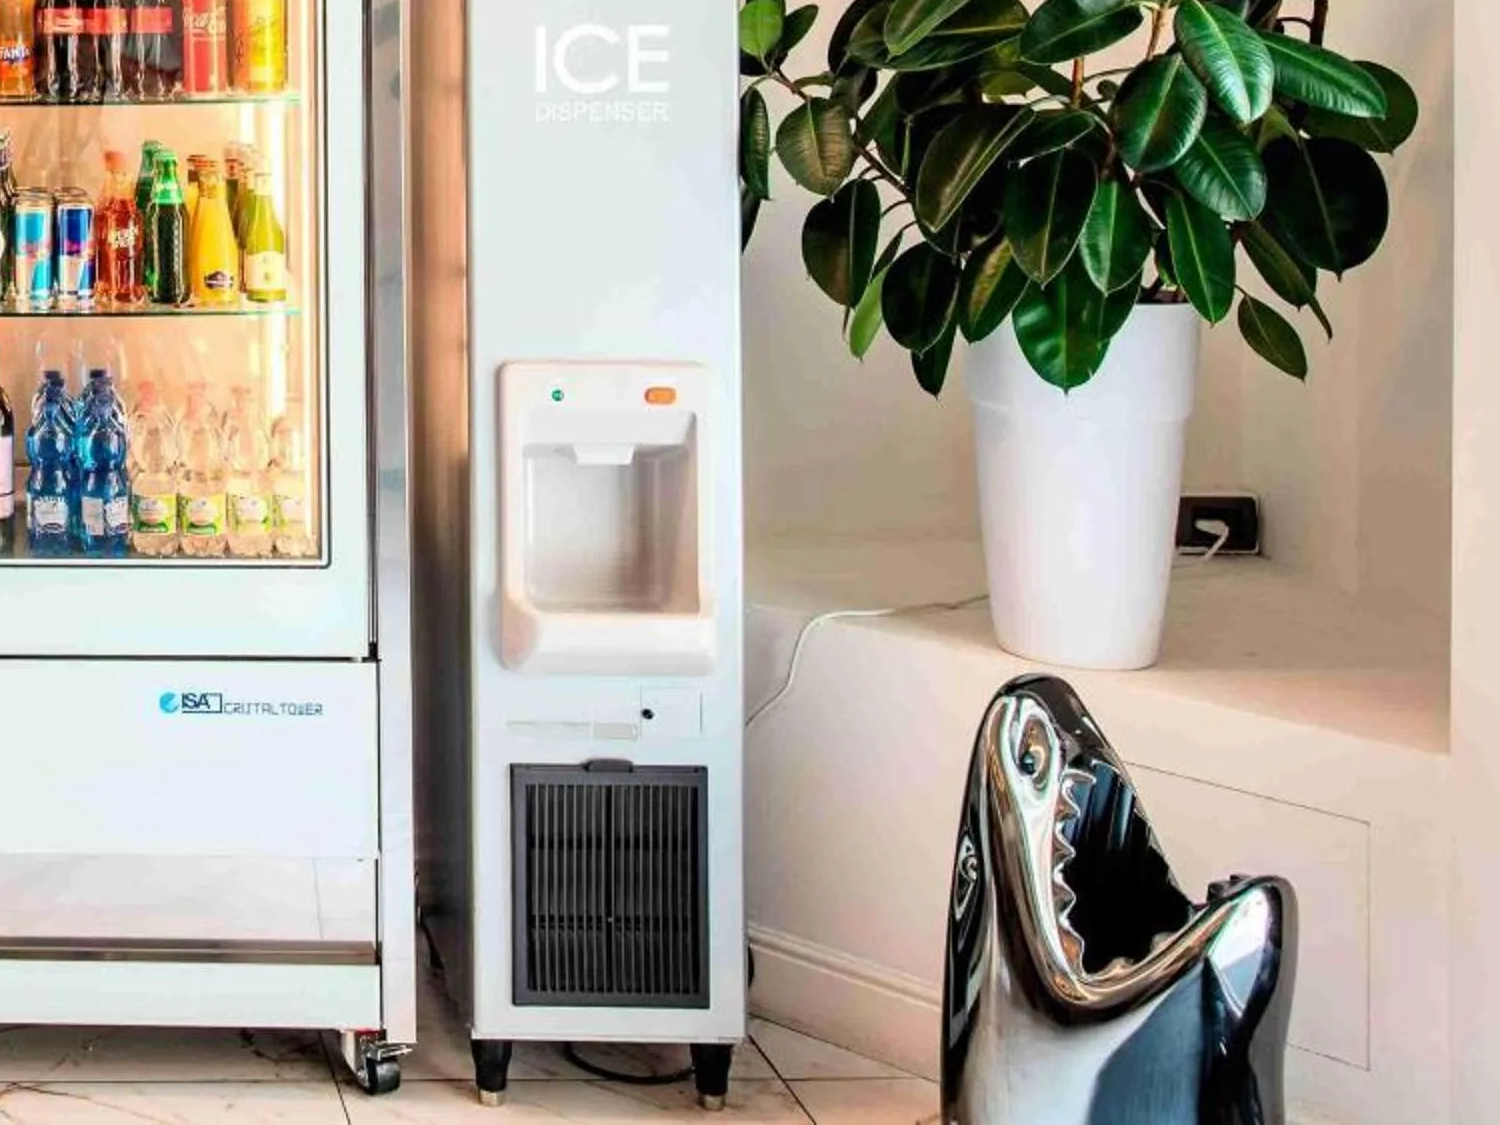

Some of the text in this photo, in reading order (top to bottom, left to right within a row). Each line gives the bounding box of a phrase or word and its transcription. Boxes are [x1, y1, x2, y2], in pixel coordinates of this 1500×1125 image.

[535, 23, 670, 93] ICE
[535, 100, 670, 122] DISPENSER
[182, 692, 211, 709] ISA
